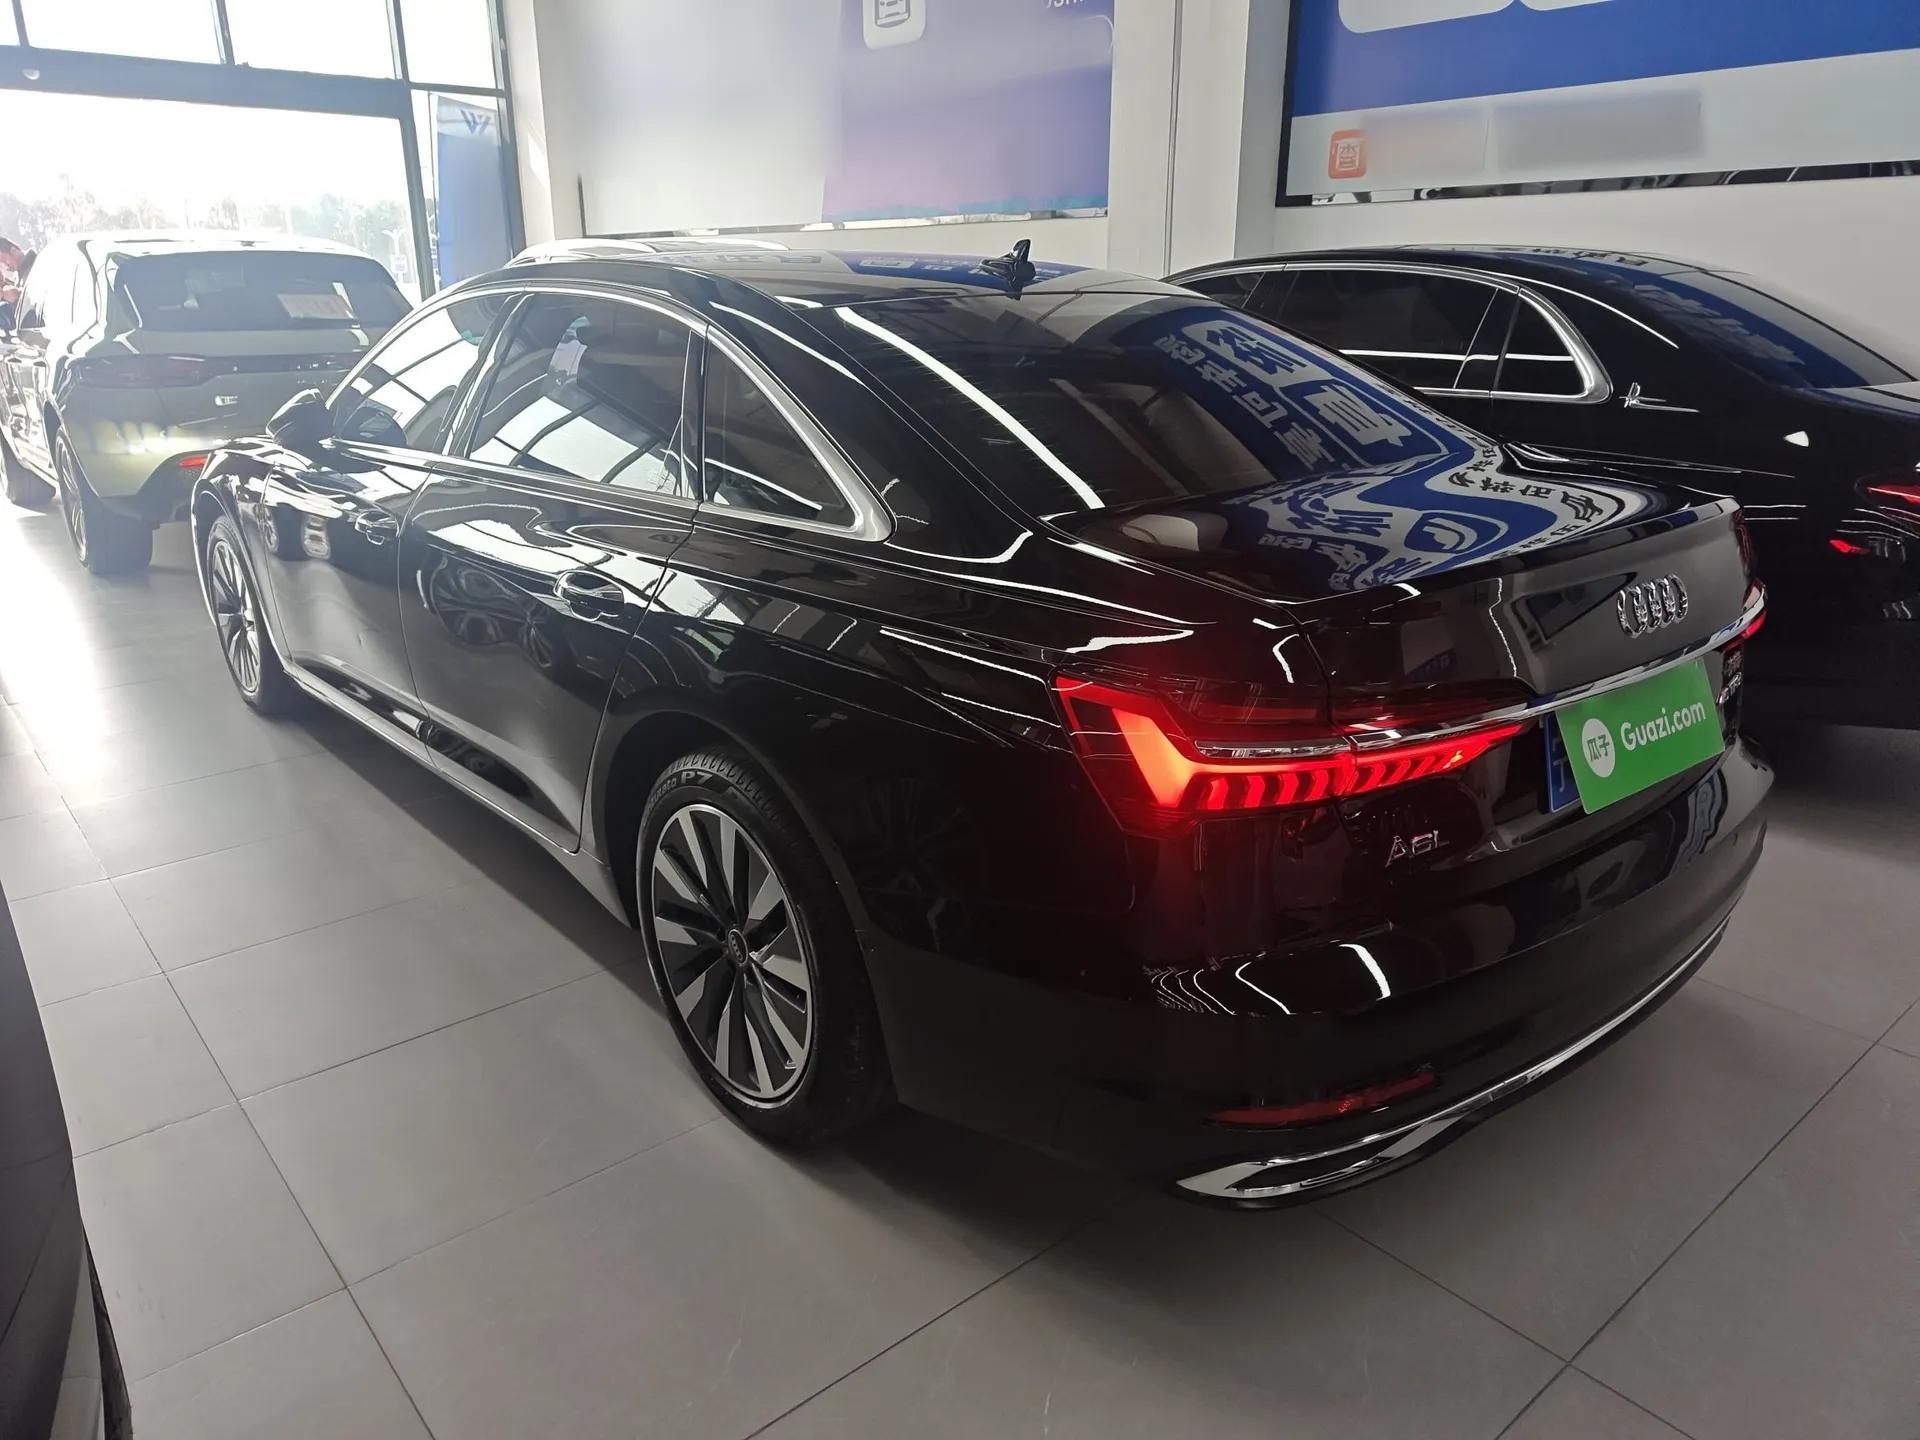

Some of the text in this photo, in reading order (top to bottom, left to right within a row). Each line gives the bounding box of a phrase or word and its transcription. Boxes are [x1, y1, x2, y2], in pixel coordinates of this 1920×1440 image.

[1620, 701, 1706, 751] Guazi.com
[1586, 733, 1610, 763] 瓜子
[681, 771, 713, 785] P7
[1385, 829, 1451, 869] A6L
